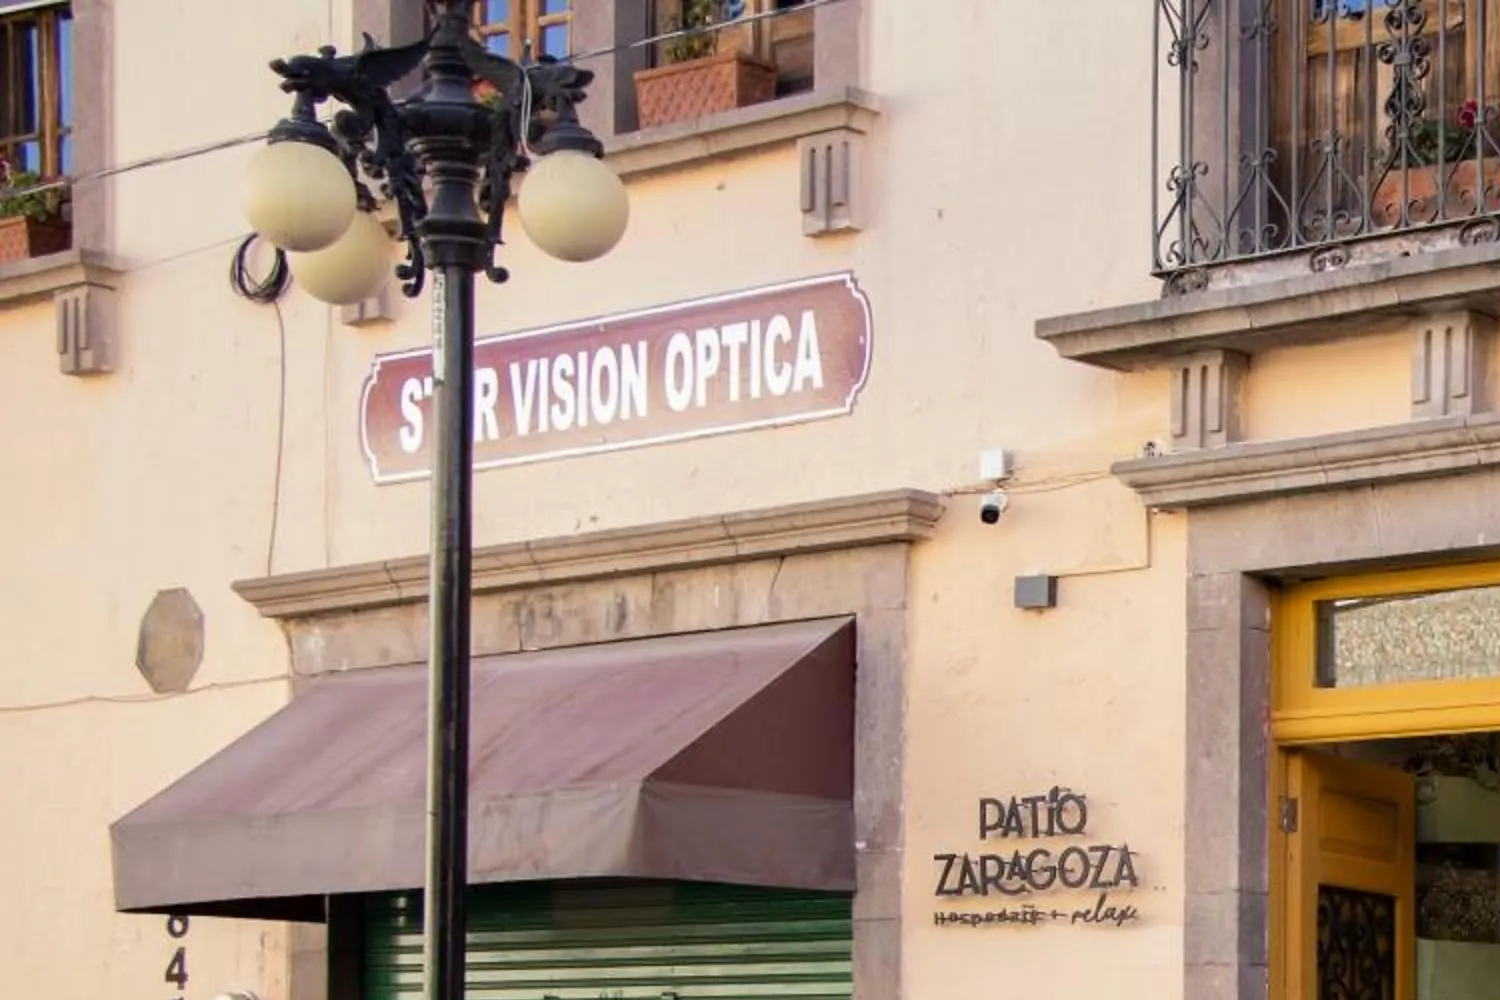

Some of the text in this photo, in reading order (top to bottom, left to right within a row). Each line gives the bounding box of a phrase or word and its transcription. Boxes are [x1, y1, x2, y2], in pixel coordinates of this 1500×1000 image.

[400, 310, 823, 453] SR VISION OPTICA
[933, 842, 1139, 896] ZARAGOZA
